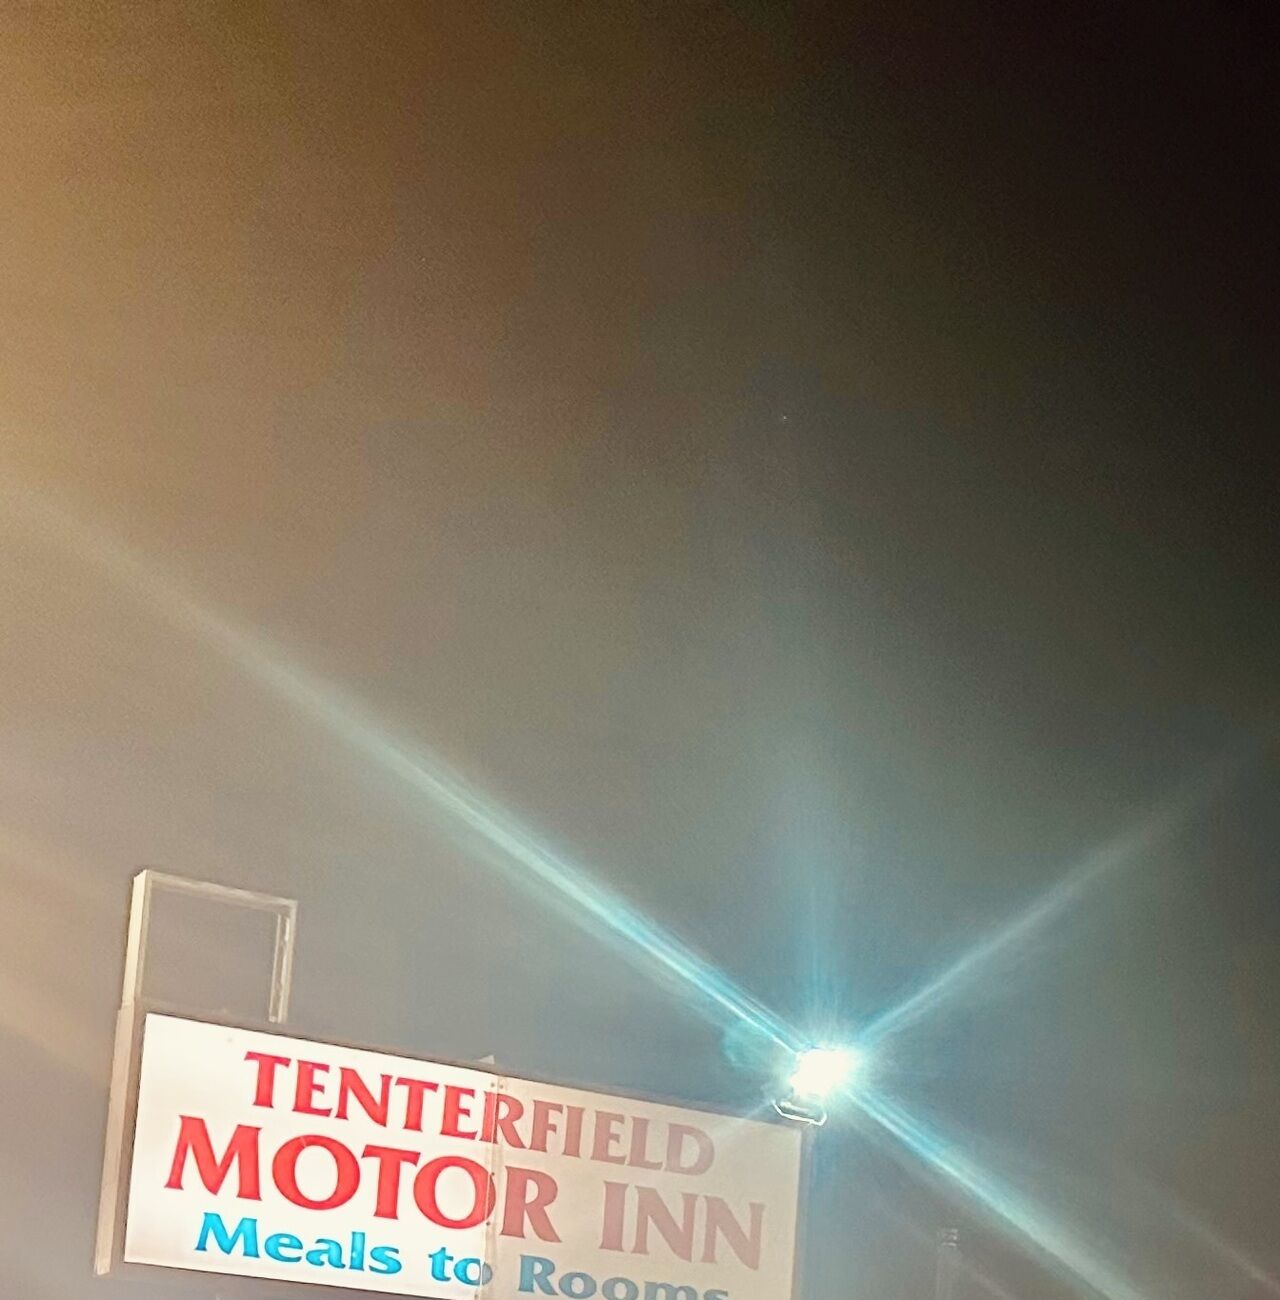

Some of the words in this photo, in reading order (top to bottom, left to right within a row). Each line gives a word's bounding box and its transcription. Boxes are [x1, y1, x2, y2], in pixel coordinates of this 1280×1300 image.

[244, 1050, 716, 1176] TENTERFIELD
[164, 1115, 562, 1244] MOTOR
[599, 1180, 767, 1271] INN
[194, 1211, 402, 1275] Meals
[428, 1246, 493, 1287] to
